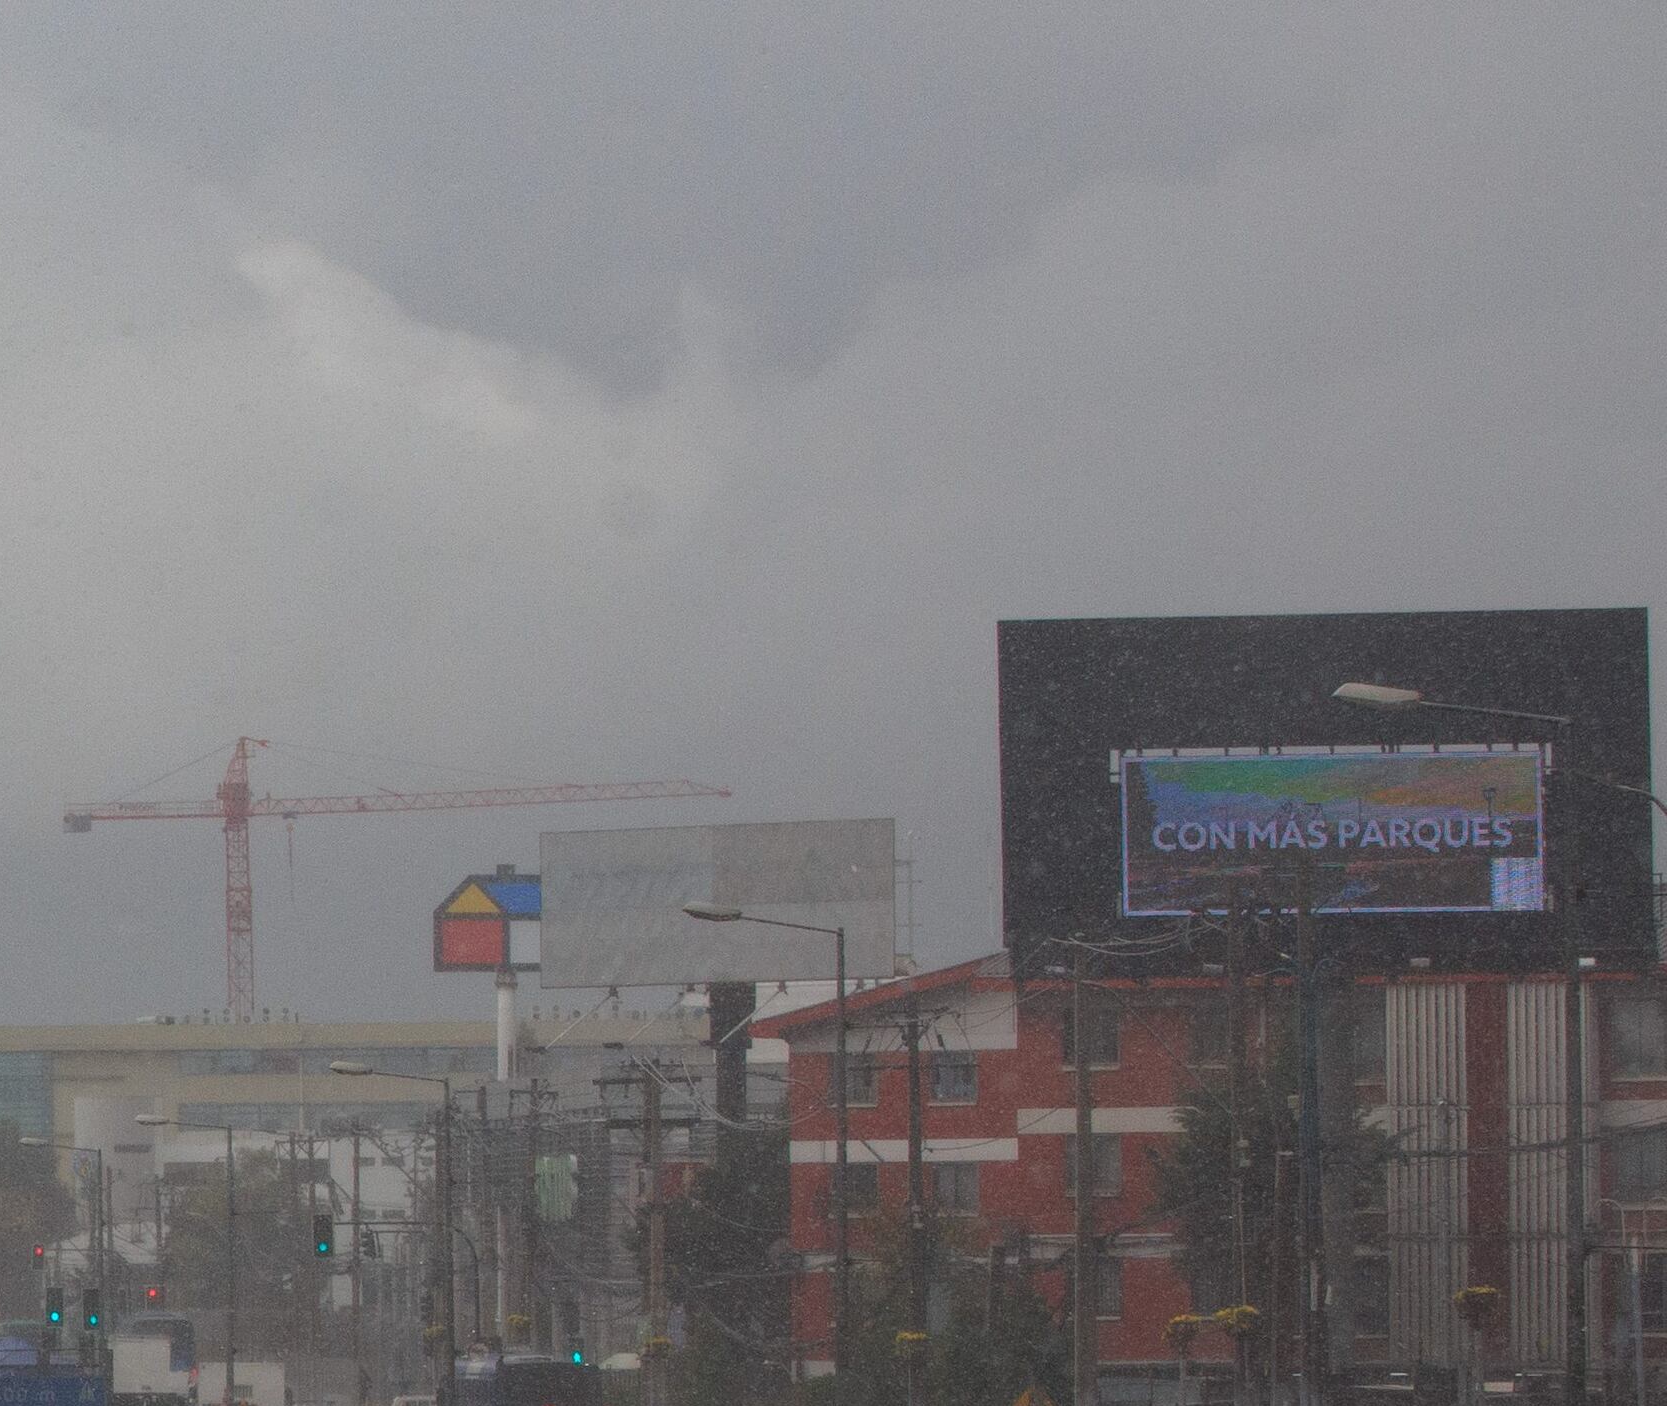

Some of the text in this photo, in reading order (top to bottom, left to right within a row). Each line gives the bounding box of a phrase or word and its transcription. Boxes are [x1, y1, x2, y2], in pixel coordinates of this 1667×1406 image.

[1152, 813, 1514, 853] CON MÁS PARQUES
